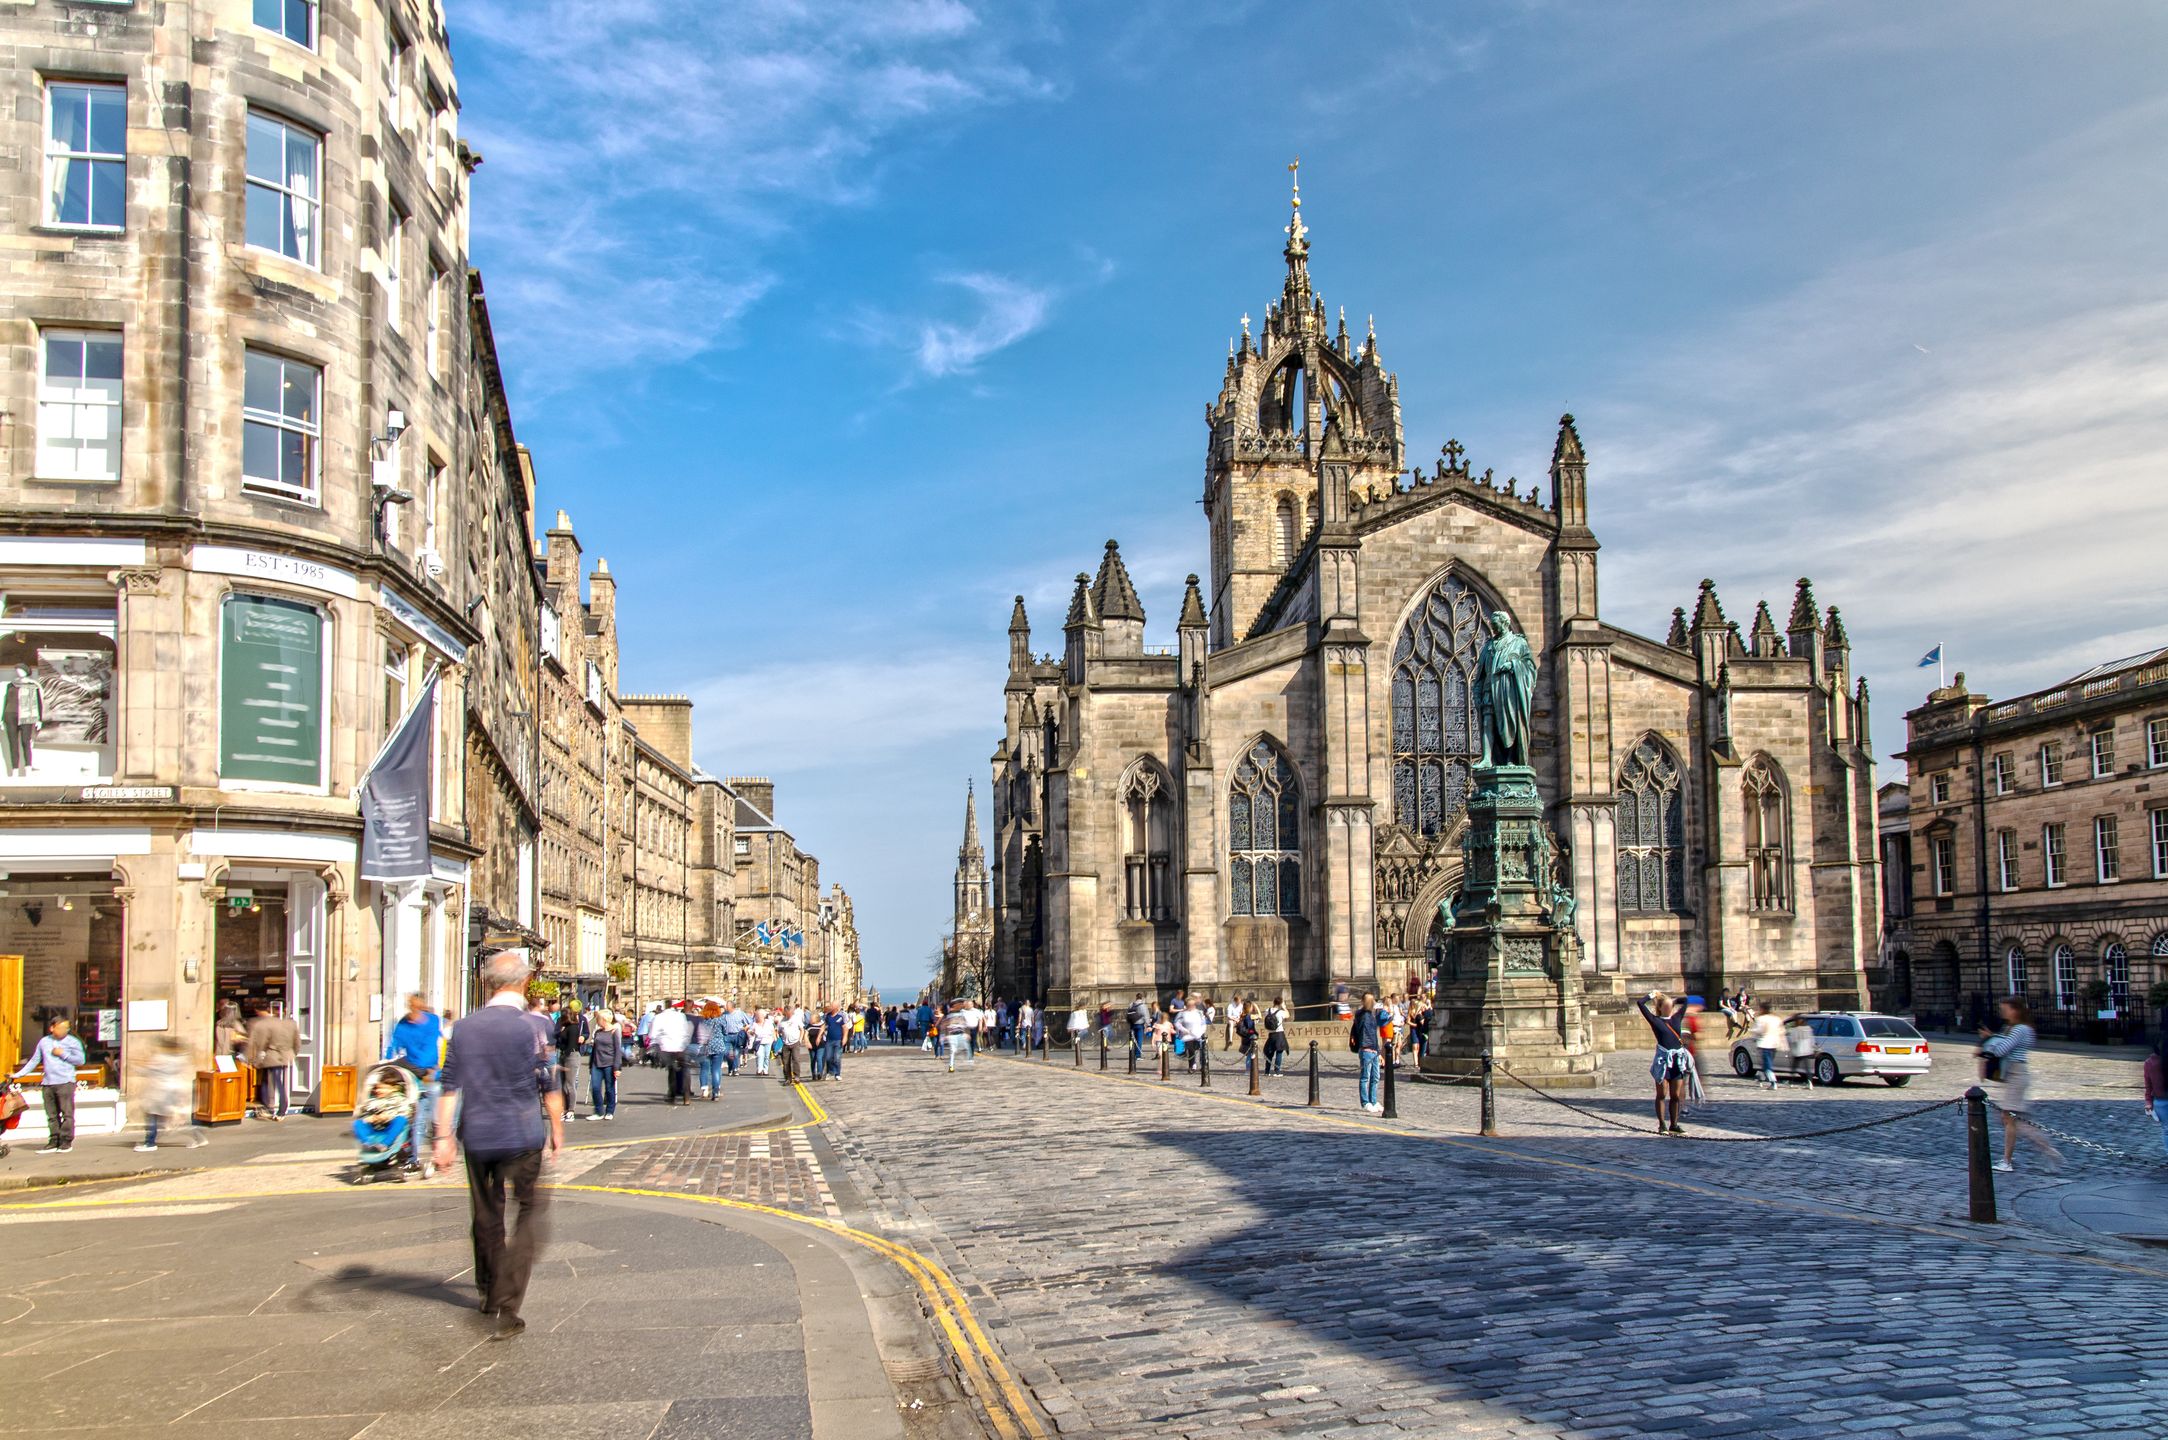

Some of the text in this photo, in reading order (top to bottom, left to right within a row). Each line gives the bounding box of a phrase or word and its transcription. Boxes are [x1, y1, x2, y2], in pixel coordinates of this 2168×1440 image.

[246, 553, 324, 579] EST 1985
[99, 789, 127, 798] GILES
[132, 789, 169, 798] STREET
[1286, 1026, 1350, 1037] ATHEDRA
